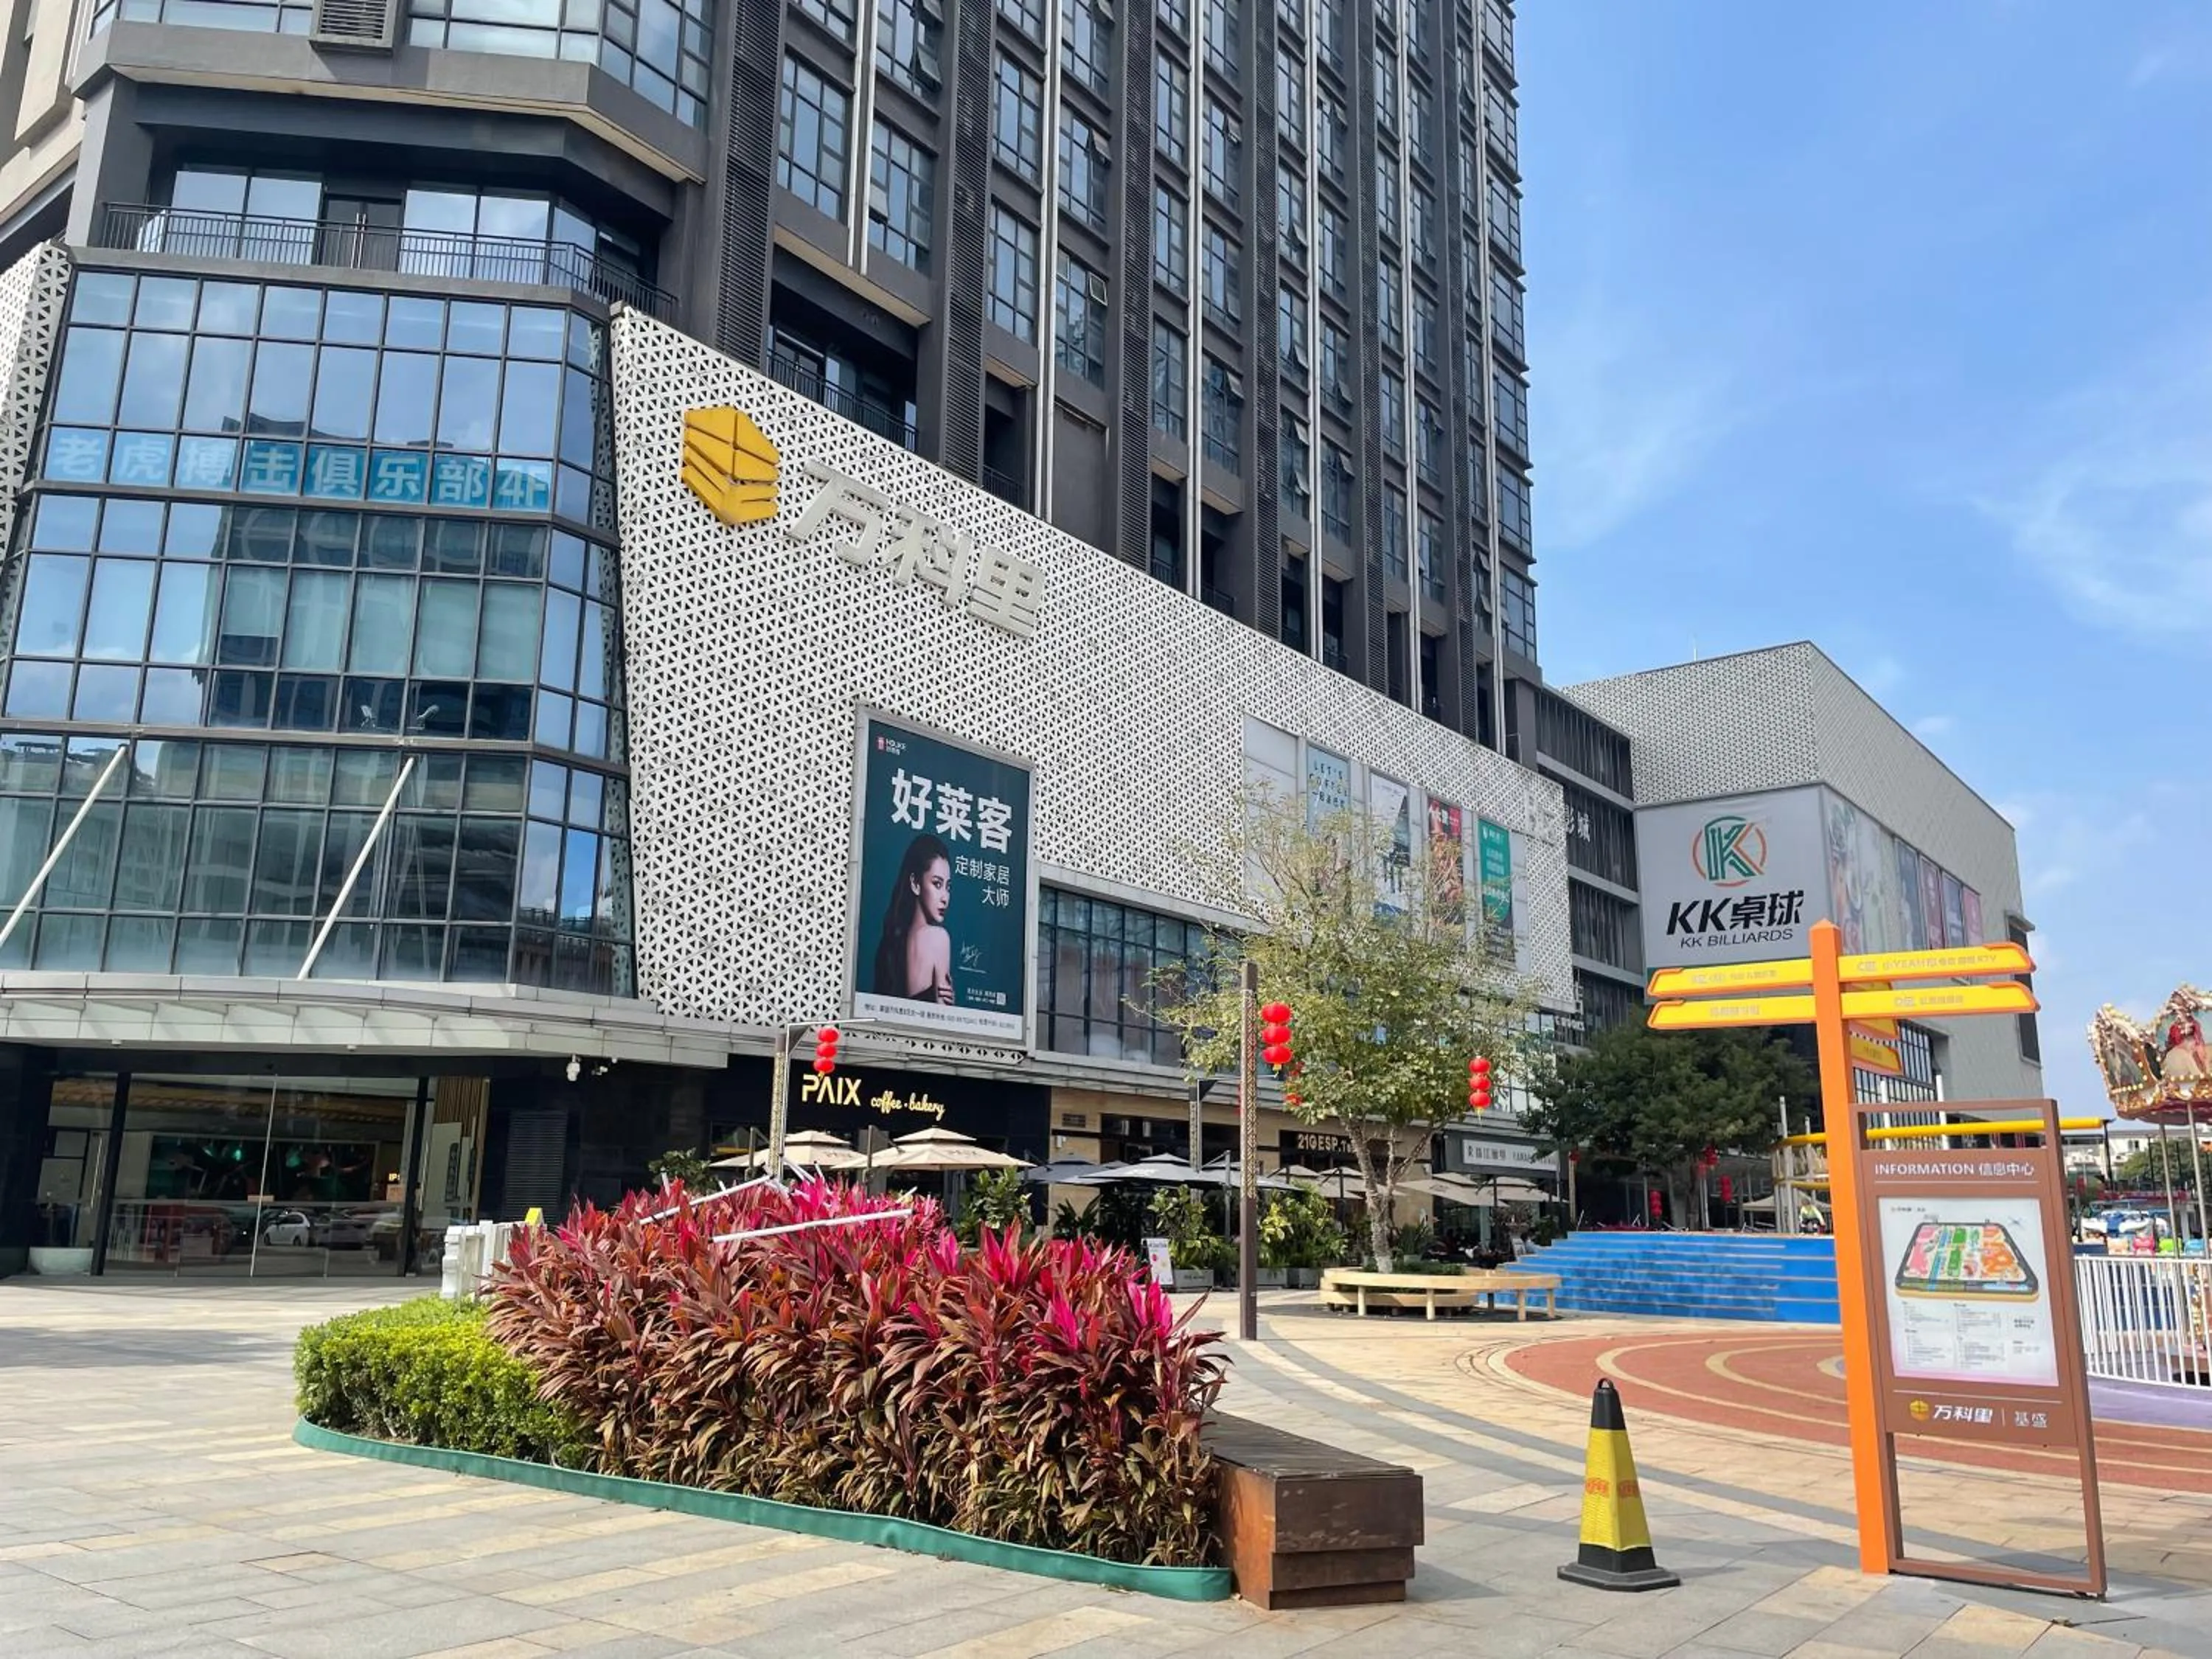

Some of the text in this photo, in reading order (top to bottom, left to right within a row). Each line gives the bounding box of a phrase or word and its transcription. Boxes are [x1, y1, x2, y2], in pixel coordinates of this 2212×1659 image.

[786, 457, 1046, 639] 万科里
[891, 768, 1012, 854] 好莱客
[955, 855, 1009, 886] 定制家居
[981, 886, 1009, 908] 大师
[1666, 890, 1804, 936] KK桌球
[1680, 928, 1793, 948] KK BILLIARDS
[801, 1074, 862, 1106] PAIX
[1875, 1162, 2034, 1176] INFORMATION 信息中心
[1933, 1404, 1994, 1424] 万科里
